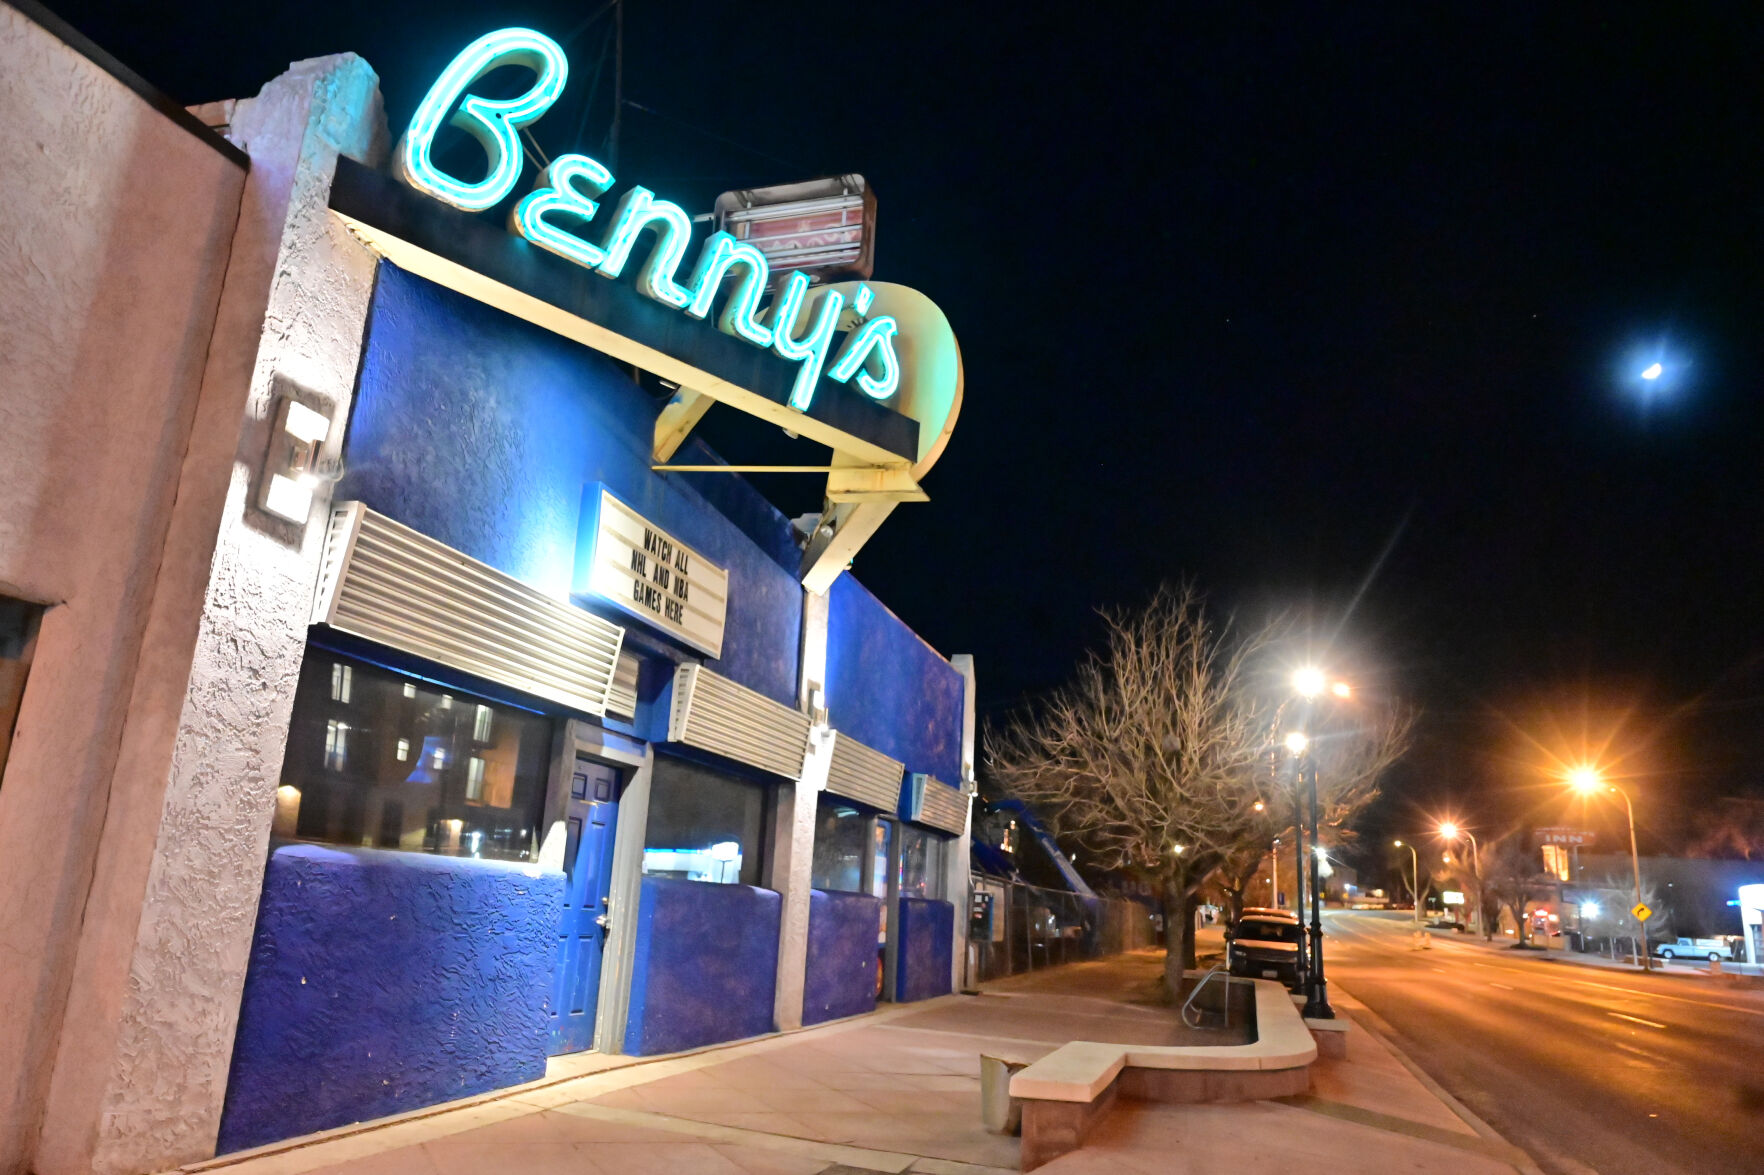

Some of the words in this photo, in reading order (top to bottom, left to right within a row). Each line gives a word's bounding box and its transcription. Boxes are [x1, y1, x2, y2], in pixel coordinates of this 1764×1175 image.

[644, 528, 673, 564] WATCH
[674, 550, 689, 575] ALL
[631, 549, 646, 577] NHL
[653, 563, 670, 590] AND
[673, 576, 688, 602] NBA
[633, 579, 661, 614] GAMES
[664, 597, 684, 625] HERE
